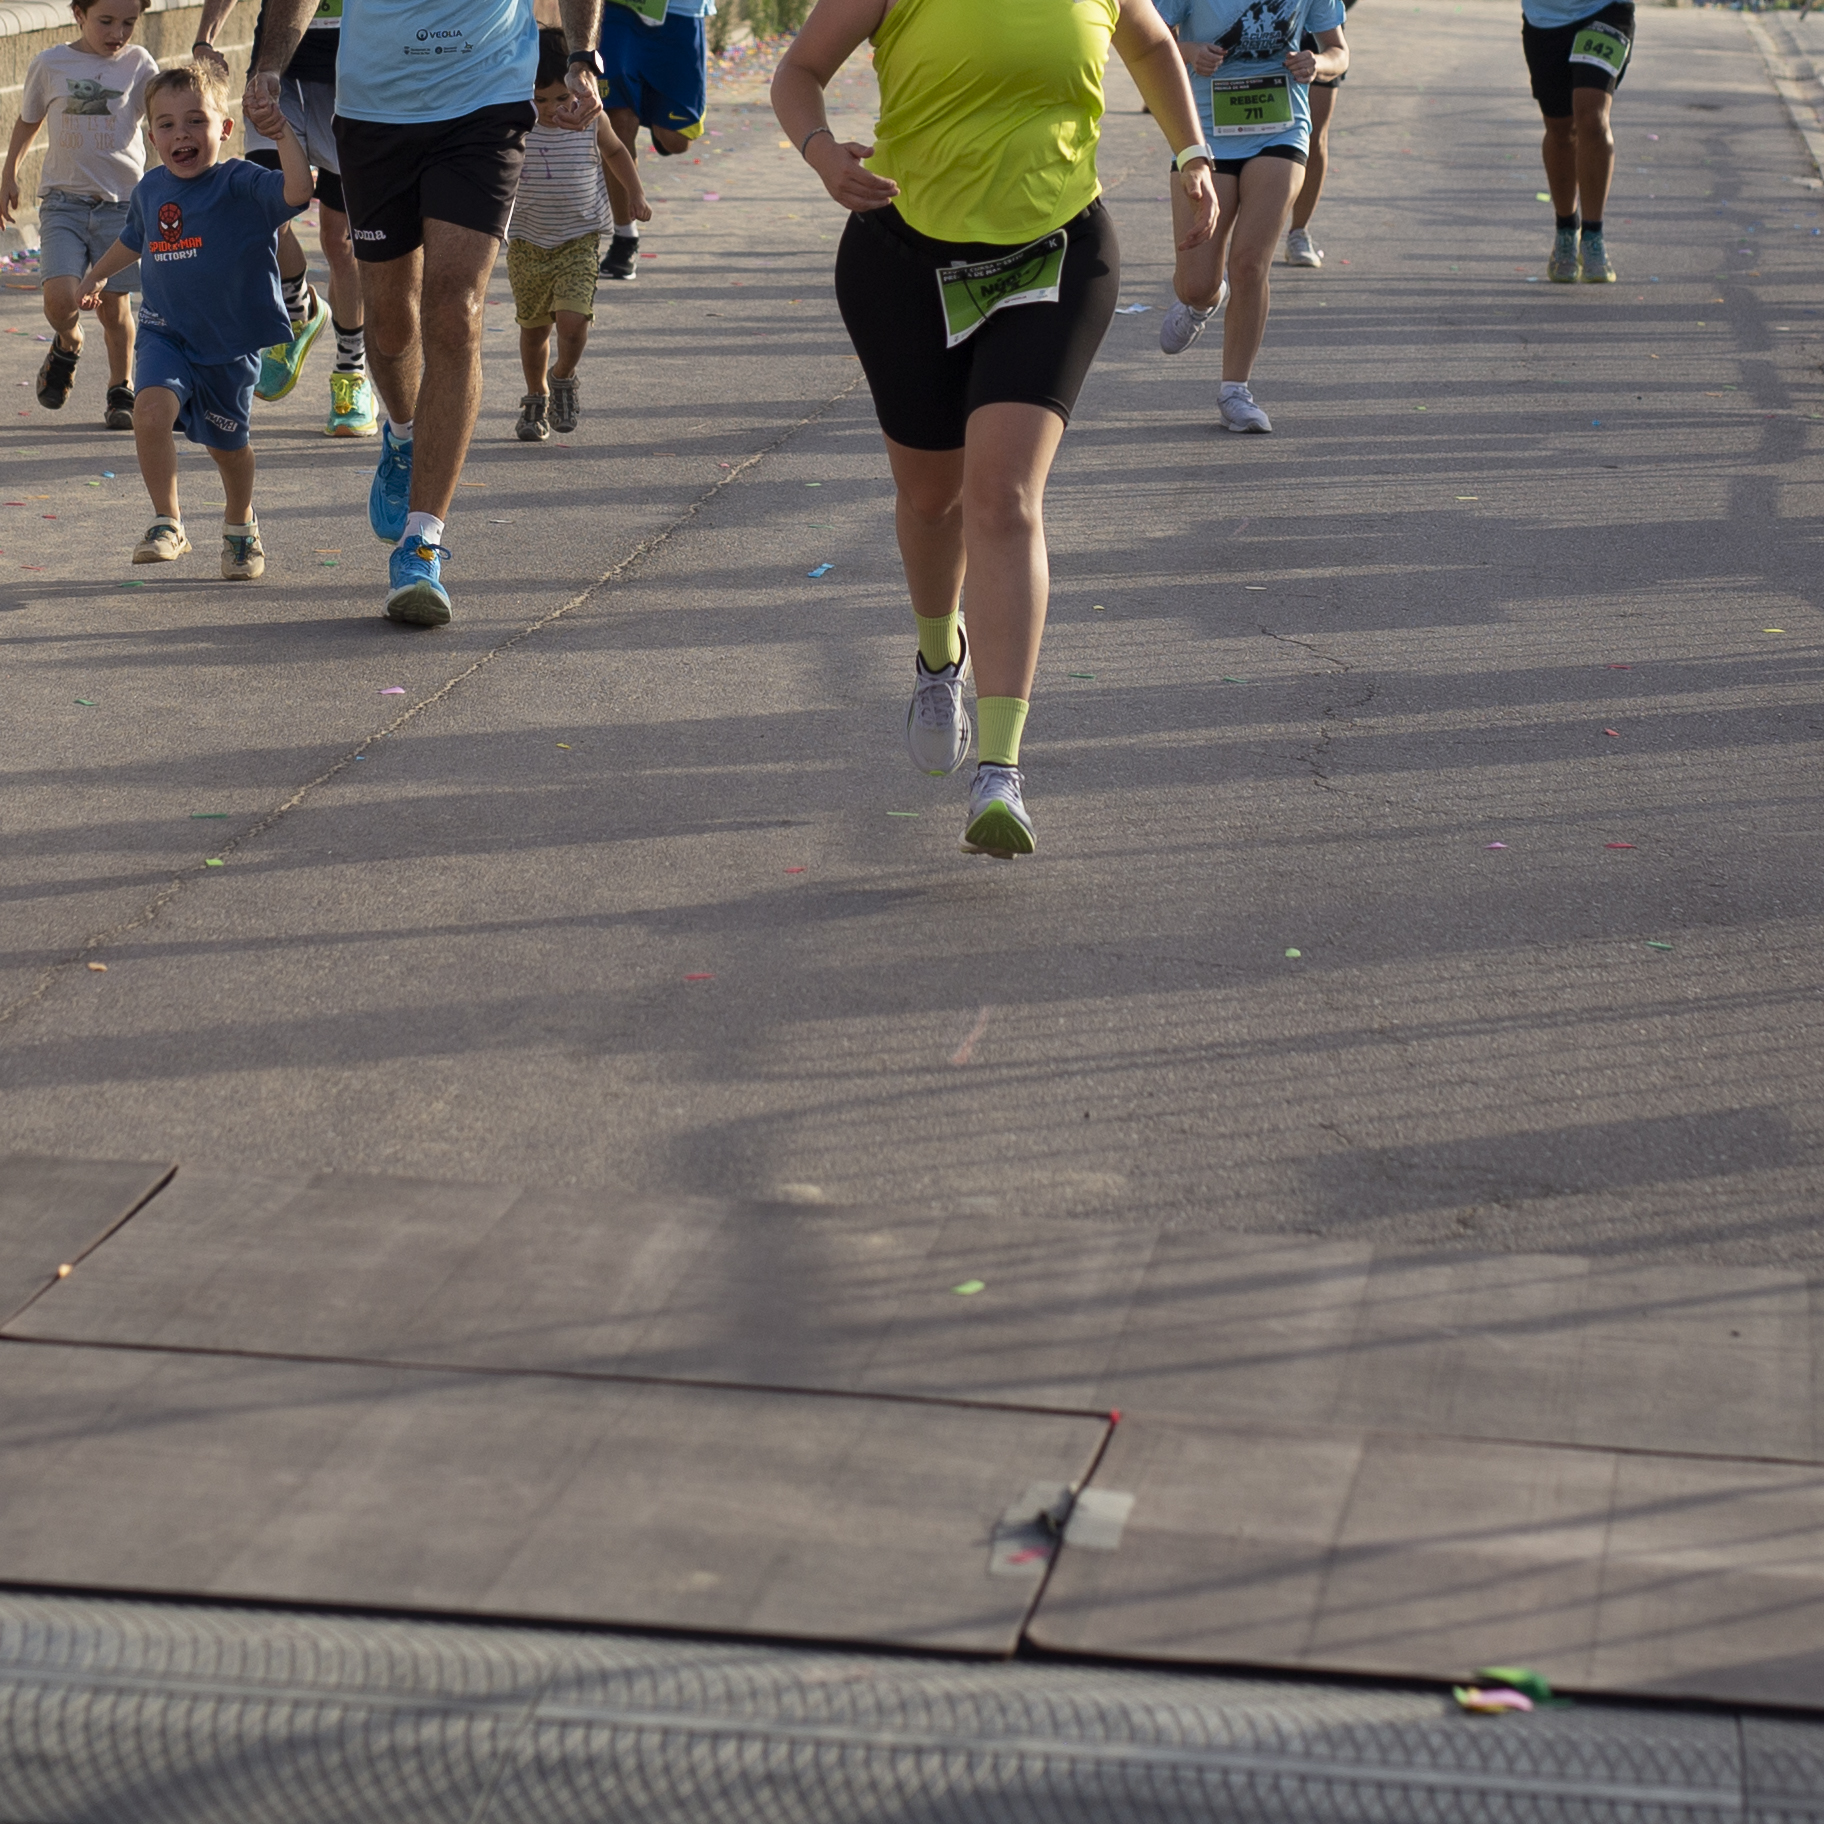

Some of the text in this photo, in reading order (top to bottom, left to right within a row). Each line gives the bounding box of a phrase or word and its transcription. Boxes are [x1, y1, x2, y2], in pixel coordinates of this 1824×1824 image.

[429, 29, 463, 39] VEOLIA
[1583, 38, 1615, 60] 842
[1229, 93, 1275, 106] REBECA
[1244, 107, 1264, 120] 711
[154, 248, 198, 262] VICTORY!
